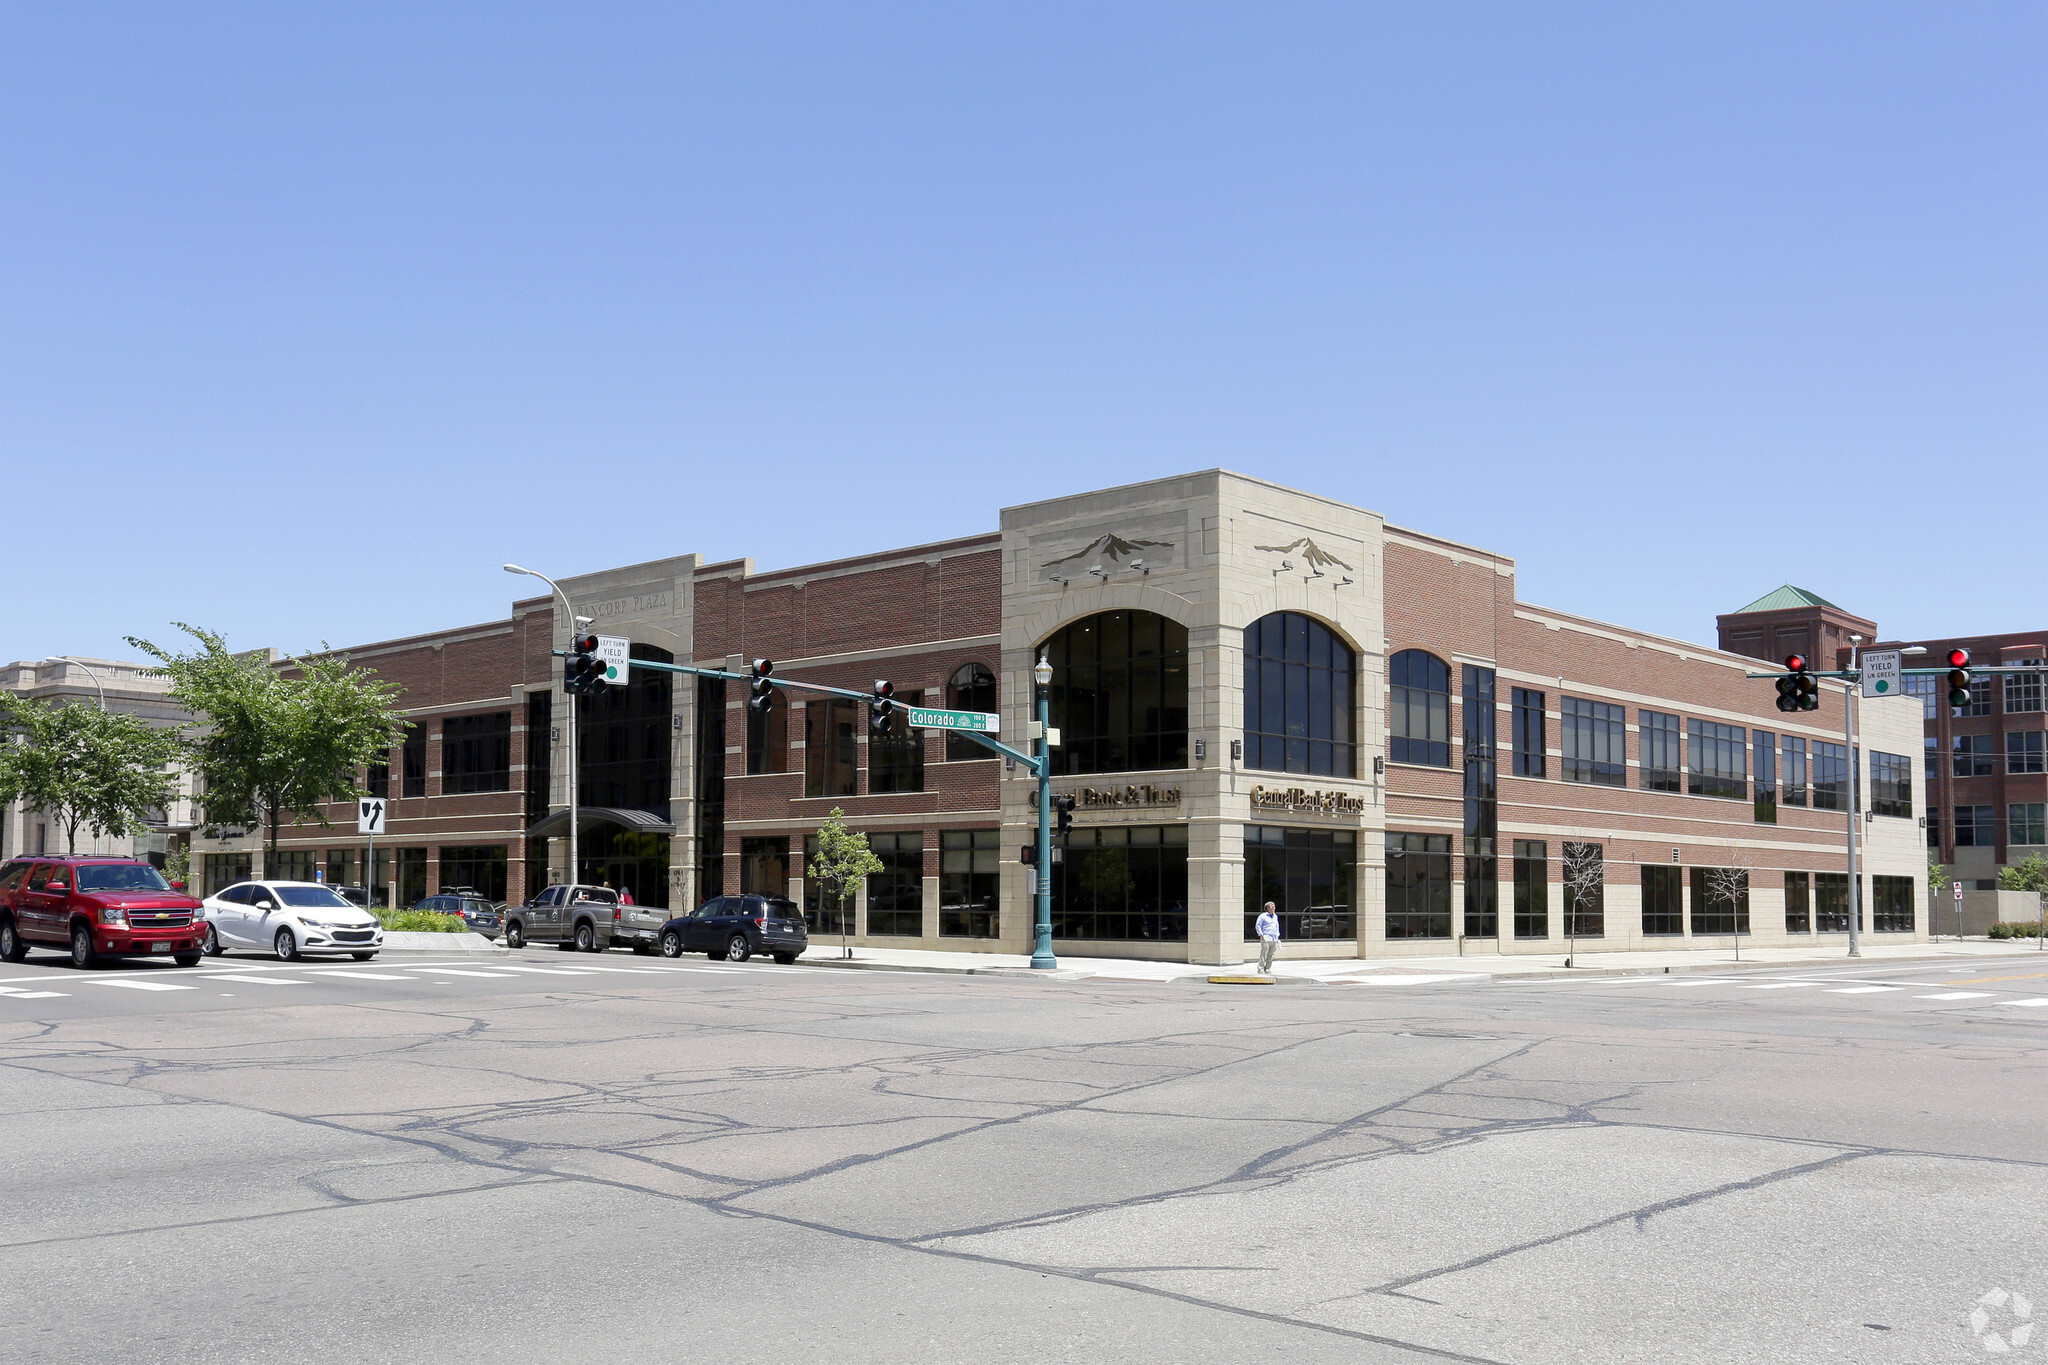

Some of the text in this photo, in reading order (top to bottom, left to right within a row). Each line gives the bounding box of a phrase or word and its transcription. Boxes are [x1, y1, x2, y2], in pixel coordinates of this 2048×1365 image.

[577, 593, 667, 618] BANCORP PLAZA
[603, 648, 621, 656] YIELD
[608, 657, 624, 665] GREEN
[1870, 662, 1892, 670] YIELD
[911, 711, 955, 726] Colorado
[1083, 786, 1122, 806] Bank
[1125, 784, 1139, 804] &
[1140, 785, 1181, 804] Trust
[1250, 784, 1364, 811] Central Bank & Trust
